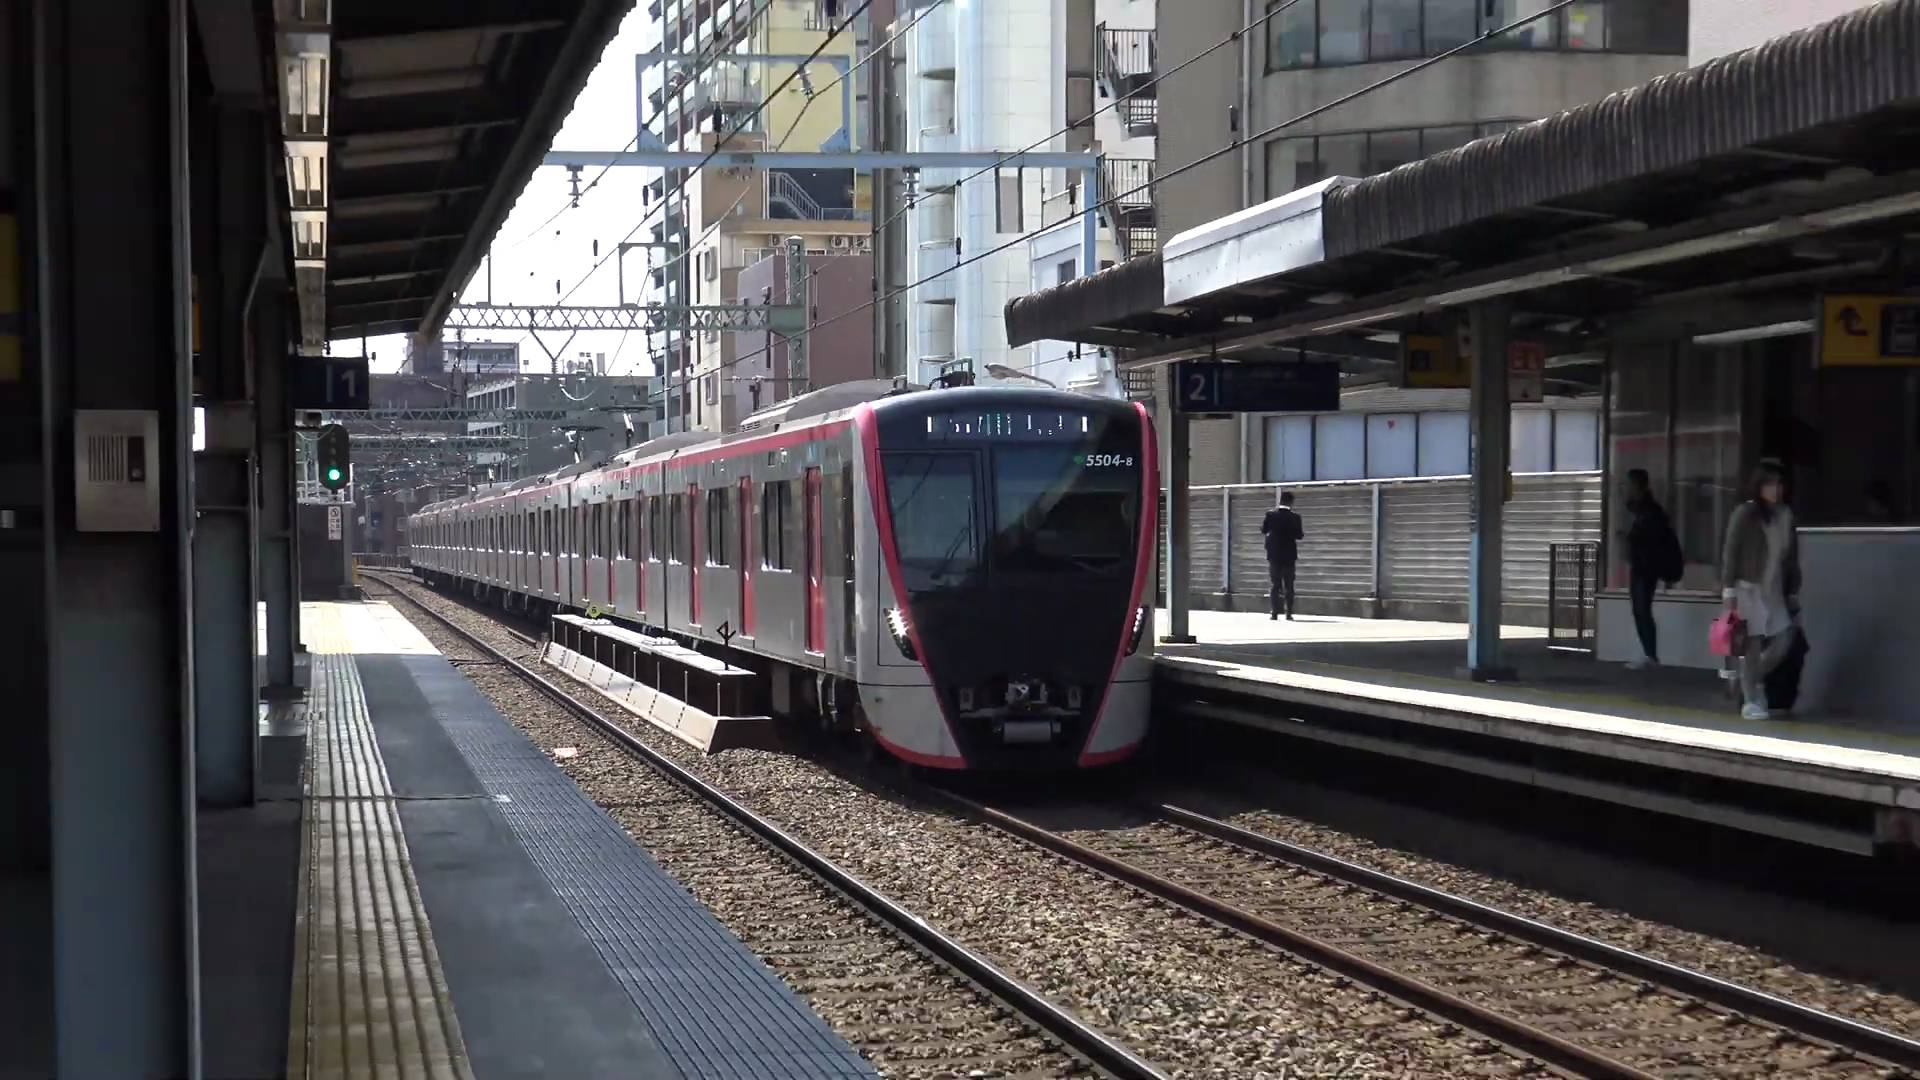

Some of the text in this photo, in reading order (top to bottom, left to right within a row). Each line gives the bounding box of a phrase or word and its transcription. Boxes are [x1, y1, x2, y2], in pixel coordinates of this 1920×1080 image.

[341, 368, 356, 398] 1
[1189, 373, 1207, 401] 2
[1086, 454, 1133, 467] 5504-8
